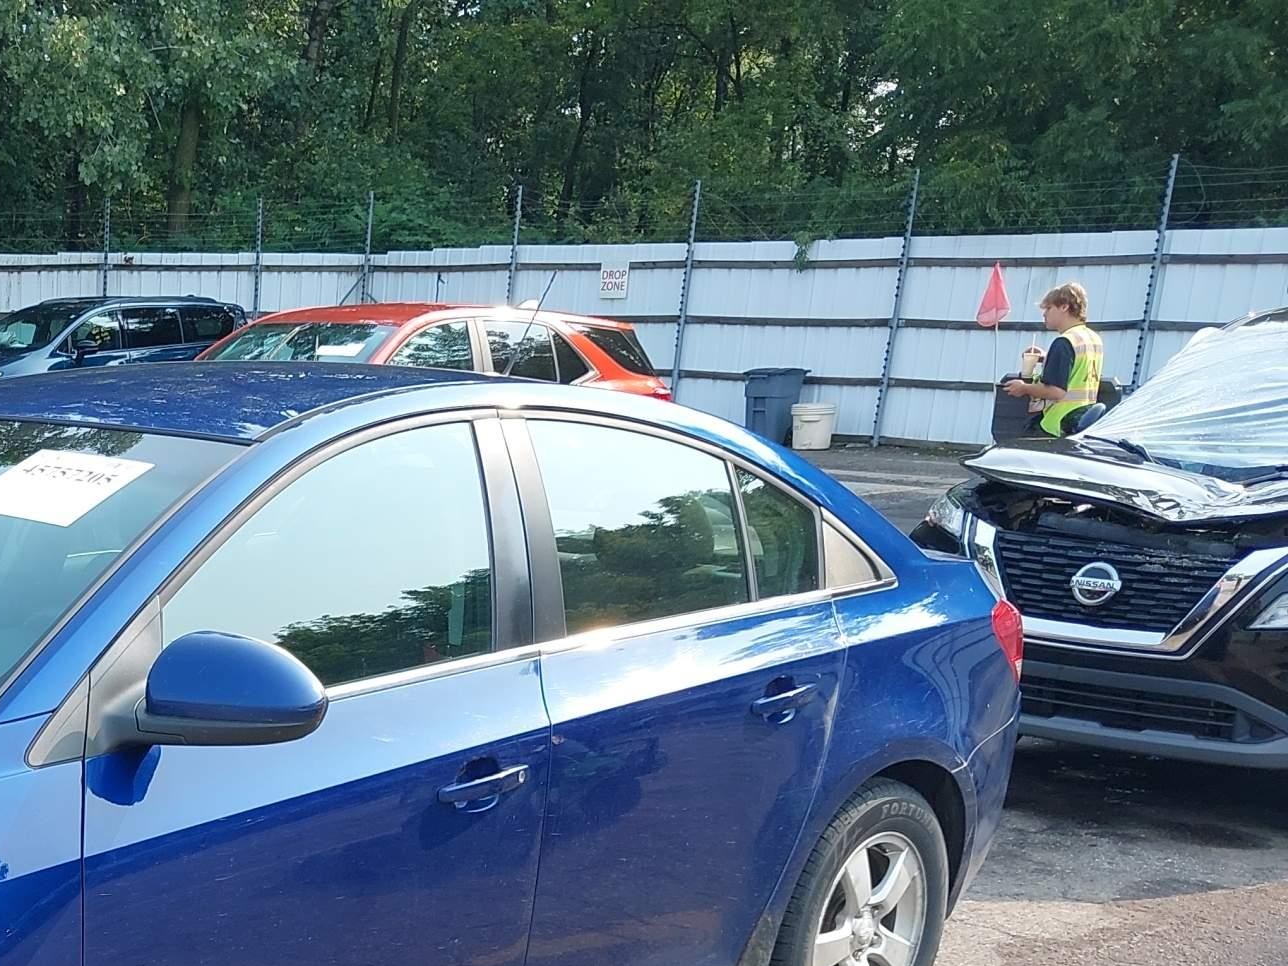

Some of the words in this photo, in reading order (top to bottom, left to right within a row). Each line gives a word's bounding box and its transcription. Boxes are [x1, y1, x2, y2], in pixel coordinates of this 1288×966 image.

[602, 270, 627, 280] DROP
[601, 281, 626, 291] ZONE
[1075, 579, 1115, 590] NISSAN
